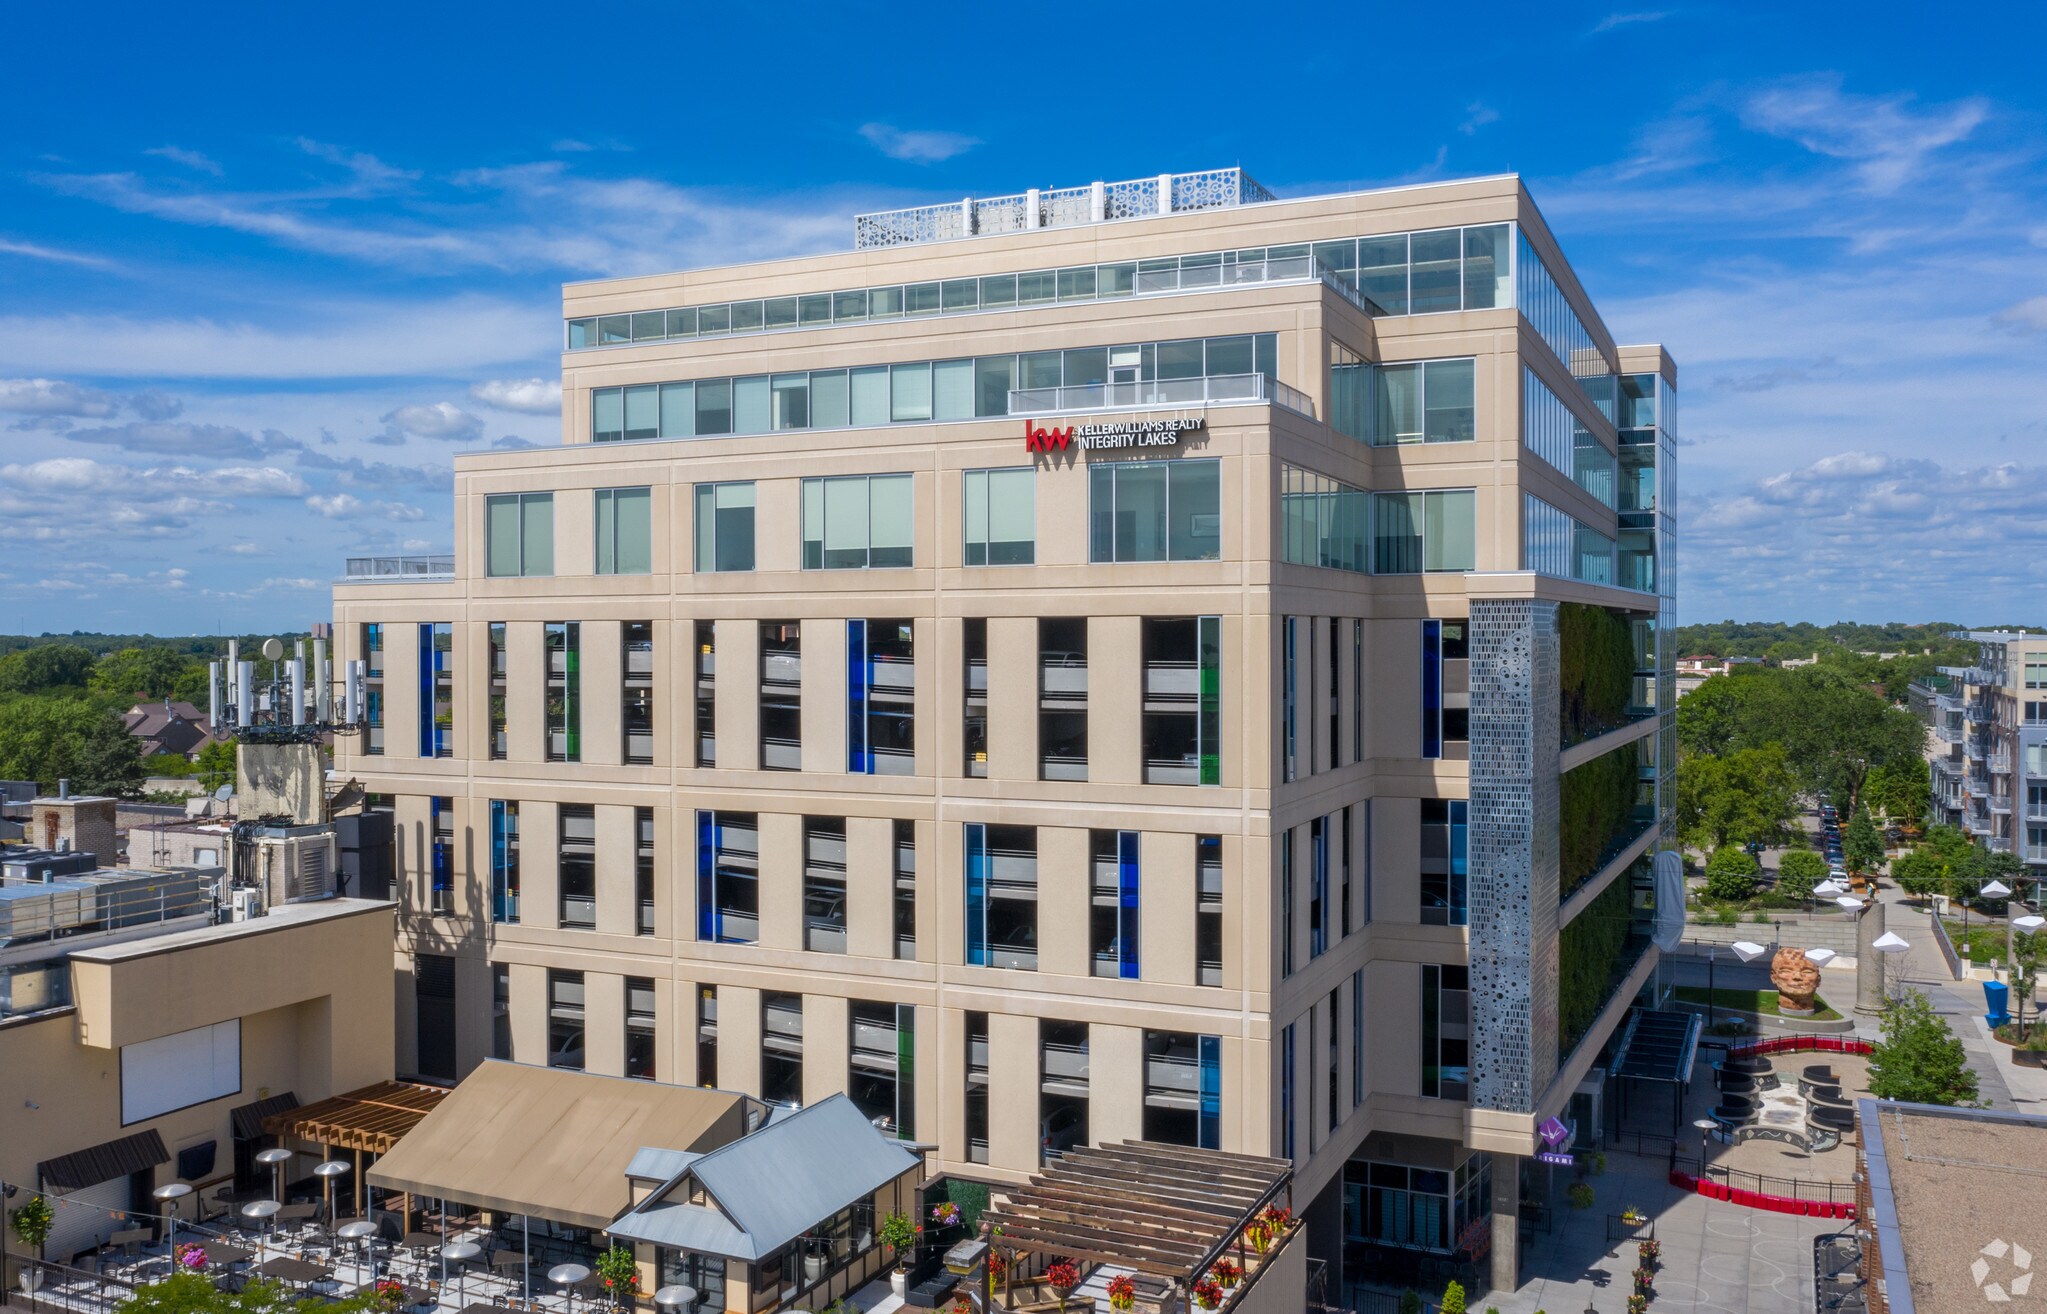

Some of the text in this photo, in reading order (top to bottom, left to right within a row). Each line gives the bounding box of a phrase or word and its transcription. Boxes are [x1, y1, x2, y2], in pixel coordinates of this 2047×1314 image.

[1165, 418, 1203, 431] REALTY
[1026, 419, 1073, 452] kw
[1078, 431, 1177, 450] INTEGRITY LAKES
